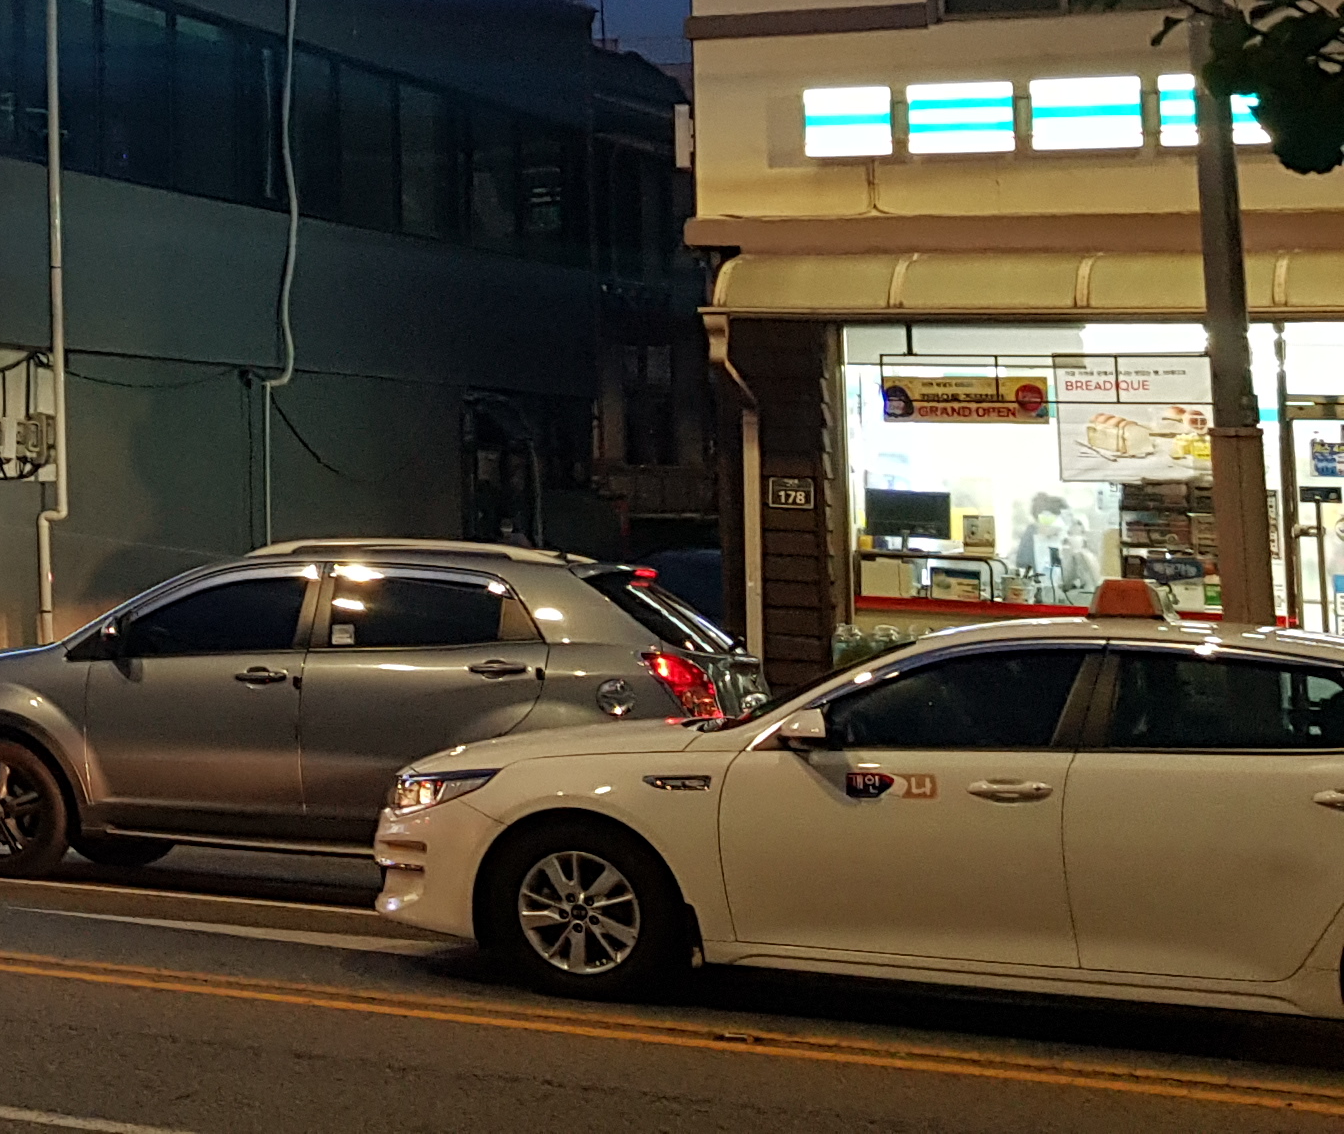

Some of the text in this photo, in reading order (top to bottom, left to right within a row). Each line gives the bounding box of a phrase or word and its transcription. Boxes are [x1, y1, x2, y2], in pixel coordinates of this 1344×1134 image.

[918, 405, 1017, 419] GRAND OPEN
[778, 490, 806, 504] 178
[849, 774, 932, 795] 개인 나
